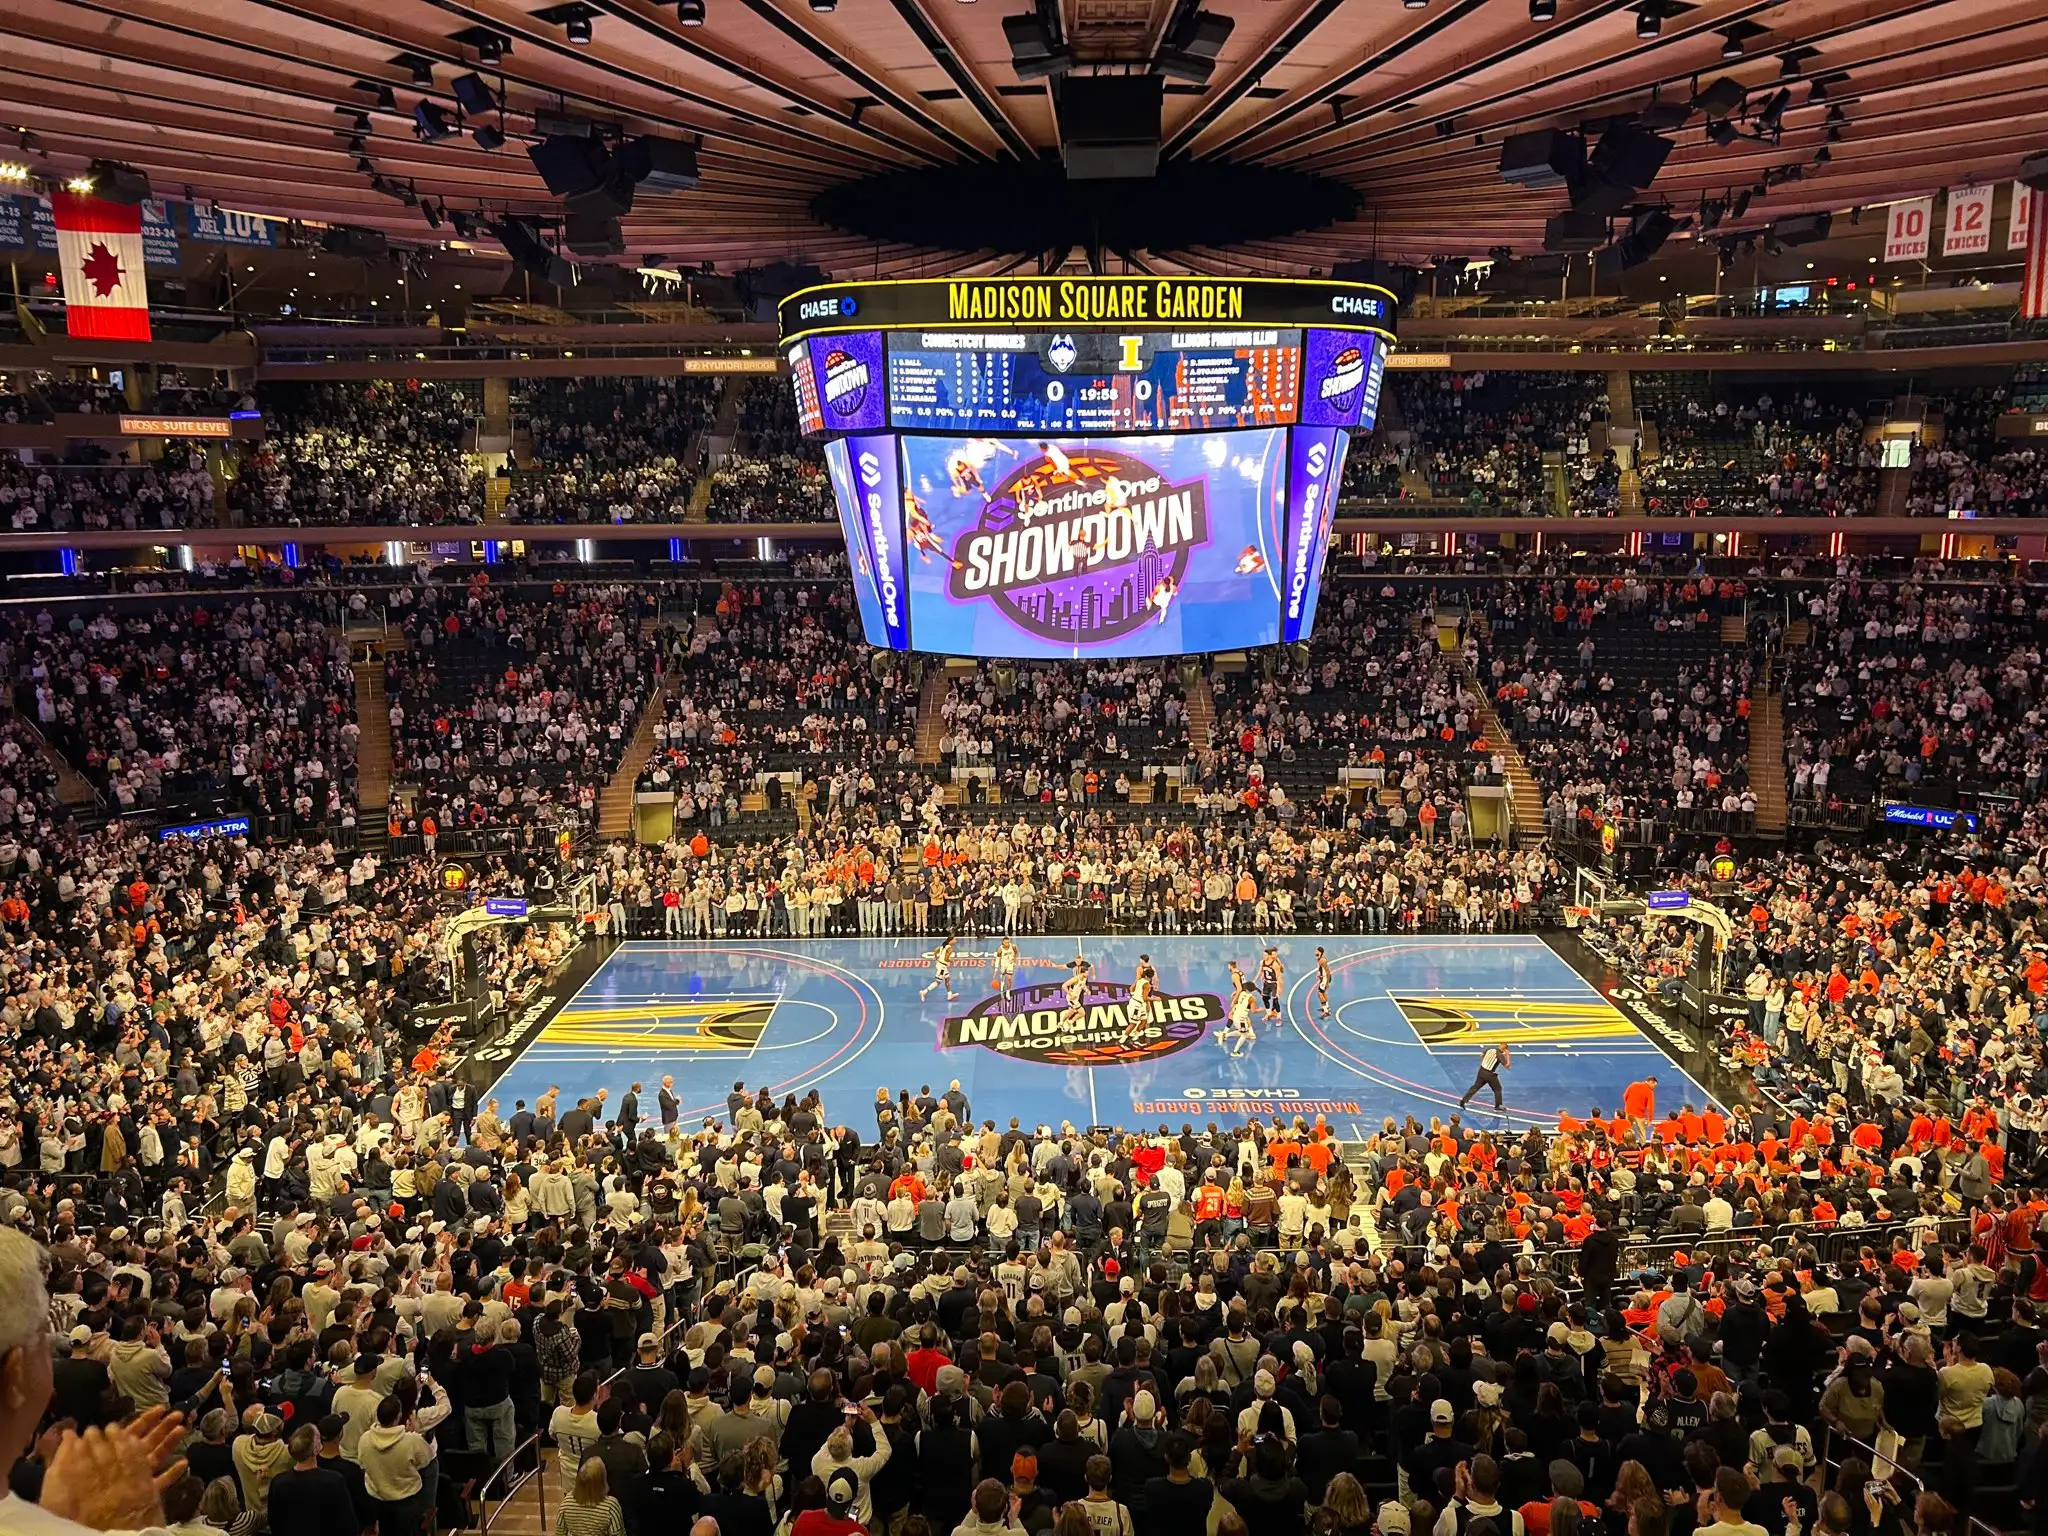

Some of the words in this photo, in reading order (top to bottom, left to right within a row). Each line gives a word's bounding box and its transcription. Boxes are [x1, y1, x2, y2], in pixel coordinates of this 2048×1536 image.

[1894, 209, 1924, 239] 10
[1953, 202, 1985, 232] 12
[197, 218, 220, 234] JOEL
[1887, 241, 1926, 257] KNICKS
[1947, 234, 1987, 250] KNICKS
[800, 298, 838, 319] CHASE
[949, 283, 1051, 319] MADISON
[1060, 281, 1148, 321] SQUARE
[1156, 281, 1243, 319] GARDEN
[1332, 296, 1377, 316] CHASE
[702, 362, 742, 370] HYUNDAI
[743, 361, 775, 369] BRIDGE
[1047, 380, 1064, 401] 0
[1092, 379, 1106, 388] 1st
[1135, 380, 1152, 400] 0
[1080, 388, 1118, 401] 19:58
[1001, 409, 1016, 419] 0.0
[1066, 407, 1073, 417] 0
[1124, 407, 1131, 416] 0
[163, 421, 194, 431] SUITE
[197, 422, 228, 432] LEVEL
[964, 490, 1193, 590] SHOWDOWN
[1288, 483, 1319, 619] SentinelOne
[867, 493, 899, 627] SentinelOne
[1886, 808, 1925, 821] Michelob
[1935, 814, 1974, 828] ULA
[878, 959, 931, 968] GARDEN
[494, 996, 556, 1046] SentinelOne
[960, 996, 1208, 1043] SHWOWN
[1627, 1000, 1696, 1053] SentinelOne
[1212, 1088, 1300, 1098] CHASE
[1133, 1102, 1202, 1115] GARDEN
[1207, 1101, 1275, 1115] SQUARE
[1280, 1102, 1362, 1115] MADISON
[1006, 1282, 1016, 1299] 11
[509, 1296, 522, 1310] 15
[1068, 1357, 1081, 1371] 11
[1676, 1415, 1700, 1427] ALLEN
[568, 1436, 583, 1454] 11
